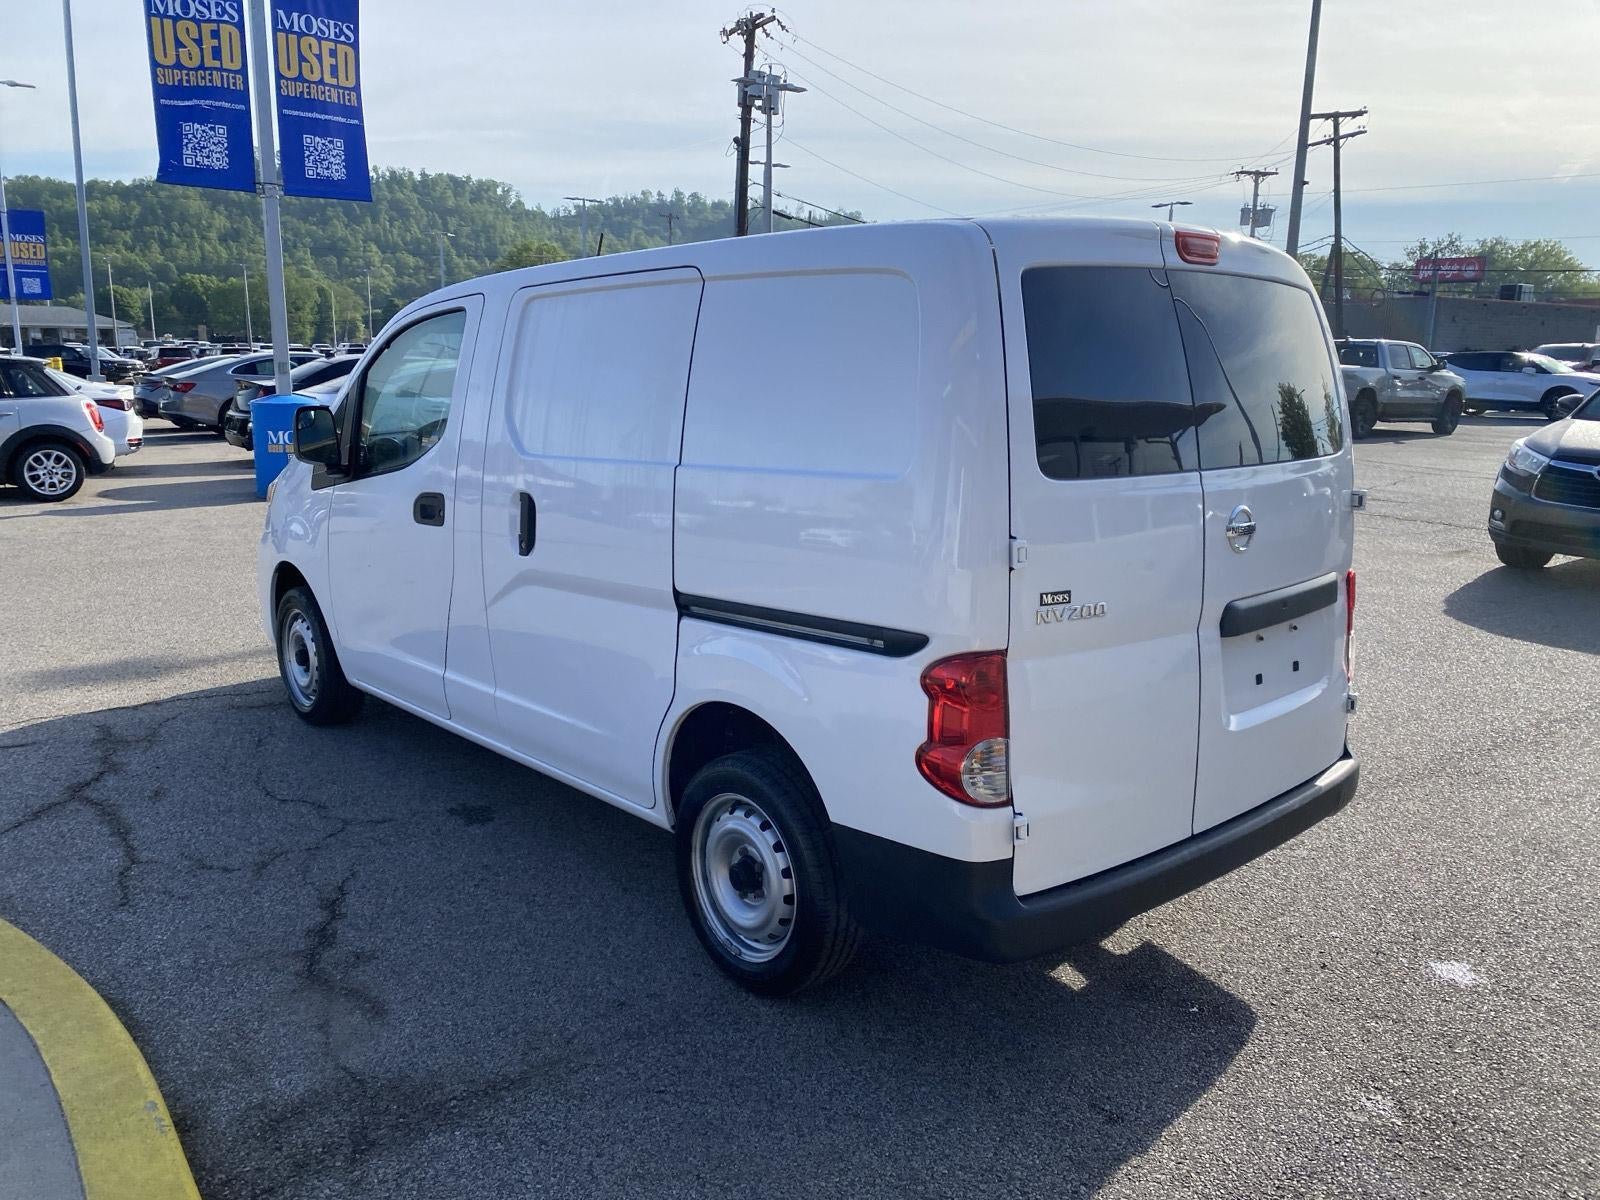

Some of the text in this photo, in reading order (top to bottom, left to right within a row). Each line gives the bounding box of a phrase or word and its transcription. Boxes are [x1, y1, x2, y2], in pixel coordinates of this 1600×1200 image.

[150, 0, 239, 23] MOSES
[276, 9, 355, 43] MOSES
[151, 16, 243, 71] USED
[277, 32, 356, 88] USED
[156, 67, 244, 91] SUPERCENTER
[280, 79, 358, 107] SUPERCENTER
[10, 233, 45, 243] MOSES
[11, 241, 46, 260] USED
[1036, 602, 1107, 626] NV200
